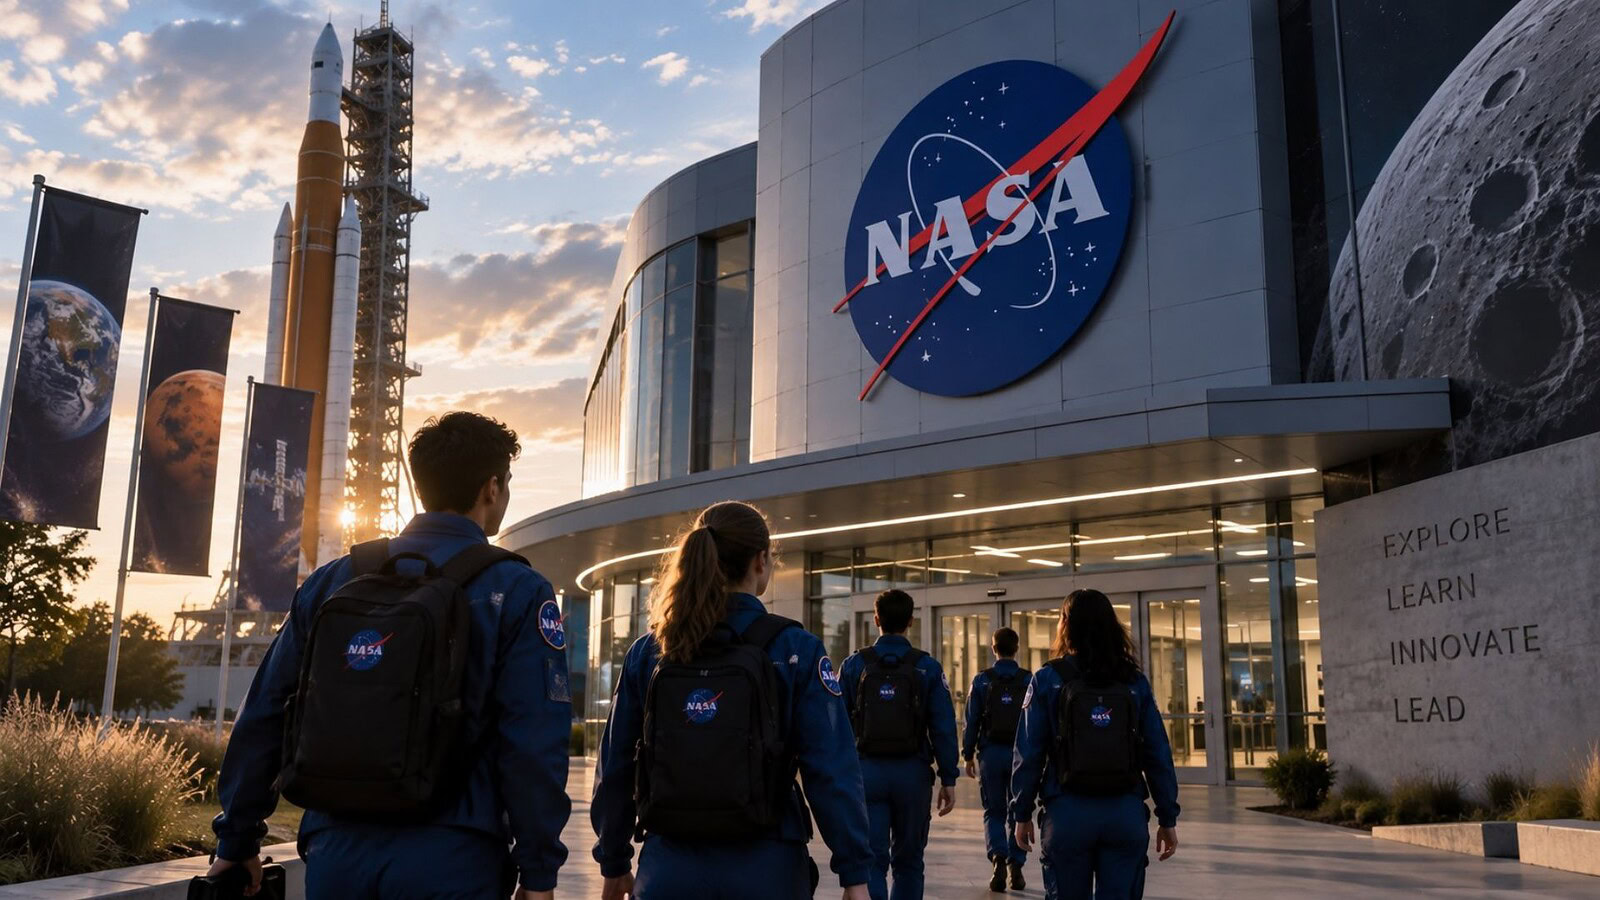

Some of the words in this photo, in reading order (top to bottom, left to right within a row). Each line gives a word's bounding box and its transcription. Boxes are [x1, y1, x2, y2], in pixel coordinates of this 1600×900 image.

[863, 153, 1110, 287] NASA
[1383, 507, 1511, 559] EXPLORE
[1387, 572, 1476, 611] LEARN
[348, 644, 383, 656] NASA
[1390, 623, 1541, 666] INNOVATE
[686, 702, 717, 711] NASA
[1394, 695, 1466, 723] LEAD
